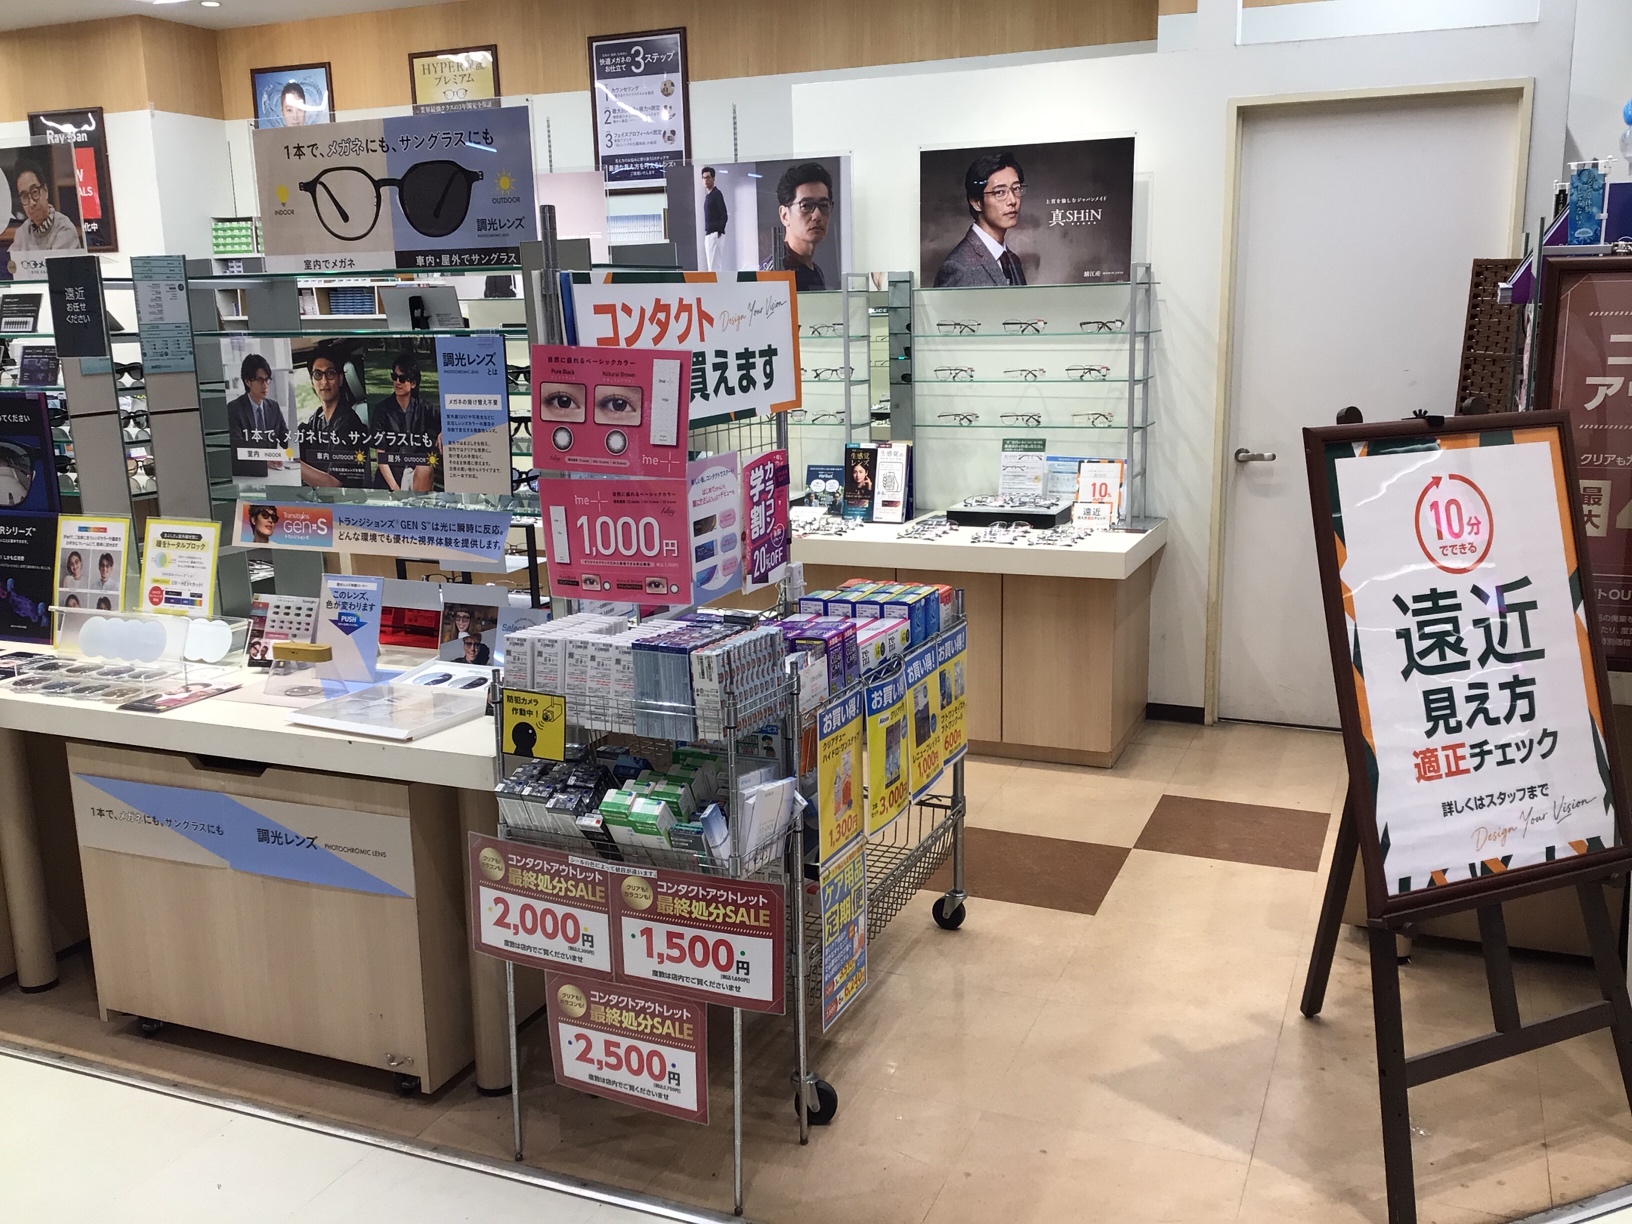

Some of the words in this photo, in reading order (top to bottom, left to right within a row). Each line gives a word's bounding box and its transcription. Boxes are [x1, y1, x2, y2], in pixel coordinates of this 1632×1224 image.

[599, 56, 631, 66] 快適メガネの
[605, 64, 626, 73] お仕立て
[434, 73, 475, 87] プレミアム
[603, 109, 612, 125] 2
[283, 127, 495, 161] 1本で、メガネにも、サングラスにも
[605, 133, 613, 148] 3
[492, 196, 521, 204] OUTDOOR
[475, 215, 525, 232] 調光レンズ
[303, 258, 356, 270] 室内でメガネ
[415, 252, 518, 267] 車内・屋外でサングラス
[64, 286, 86, 300] 遠近
[65, 314, 91, 324] ください
[66, 302, 87, 312] お任せ
[719, 310, 747, 333] Design
[747, 299, 765, 327] Your
[765, 295, 787, 319] Vision
[592, 296, 715, 348] コンタクト
[442, 351, 497, 367] 調光レンズ
[547, 356, 636, 366] 自然に盛れるベーシックカラー
[487, 368, 498, 376] とは
[690, 343, 778, 403] 買えます
[242, 428, 433, 448] 1本で、メガネにも、サングラスにも
[247, 450, 260, 458] 室内
[850, 452, 870, 460] 生感覚
[749, 464, 766, 540] 学割
[765, 460, 775, 534] カラコン
[1083, 507, 1101, 516] 遠近
[1430, 498, 1482, 541] 10分
[400, 520, 418, 531] GEN
[577, 515, 678, 558] 1,000円
[337, 530, 502, 550] どんな環境でも優れた視界体験を提供します。
[1439, 542, 1478, 557] でできる
[325, 600, 376, 612] 色が変わります
[333, 590, 370, 602] このレンズ、
[340, 615, 357, 623] PUSH
[1392, 575, 1546, 682] 遠近
[938, 631, 965, 662] お買い得!
[906, 651, 936, 684] お買い得!
[506, 694, 540, 707] 防犯カメラ
[511, 705, 540, 719] 作動中!
[1422, 674, 1538, 739] 見え方
[822, 694, 861, 734] お買い得!
[822, 733, 847, 752] クリアデュー
[912, 735, 941, 764] レニューフレッシュ
[943, 728, 962, 752] 600円
[917, 751, 939, 779] 1,000円
[1413, 727, 1559, 784] 適正チェック
[879, 781, 908, 816] 3,000円
[1441, 783, 1550, 818] 詳しくはスタッフまで
[90, 806, 225, 836] 1本で、メガネにも、サングラスにも
[828, 813, 858, 848] 1,300円
[1471, 826, 1518, 852] Design
[1520, 806, 1548, 838] Your
[1553, 796, 1597, 824] Vision
[256, 827, 318, 850] 調光レンズ
[324, 842, 371, 857] PHOTOCHROMIC
[371, 849, 387, 858] LENS
[508, 854, 603, 883] コンタクトアウトレット
[569, 856, 658, 878] シールの色によって値段が違います。
[507, 867, 606, 903] 最終処分SALE
[626, 884, 648, 892] クリアも!
[657, 881, 768, 906] コンタクトアウトレット
[825, 855, 864, 909] ケア用品
[624, 891, 651, 900] カラコンも!
[493, 896, 595, 949] 2,000円
[656, 894, 771, 927] 最終処分SALE
[824, 879, 864, 942] 定期便
[503, 939, 583, 963] 度数は店内でご覧くださいませ
[640, 926, 750, 976] 1,500円
[652, 970, 742, 993] 度数は店内でご覧くださいませ
[560, 999, 585, 1009] カラコンも!
[562, 992, 582, 1001] クリアも!
[590, 991, 692, 1020] コンタクトアウトレット
[590, 1003, 694, 1041] 最終処分SALE
[574, 1033, 681, 1087] 2,500円
[588, 1073, 670, 1100] 度数は店内でご覧くださいませ
